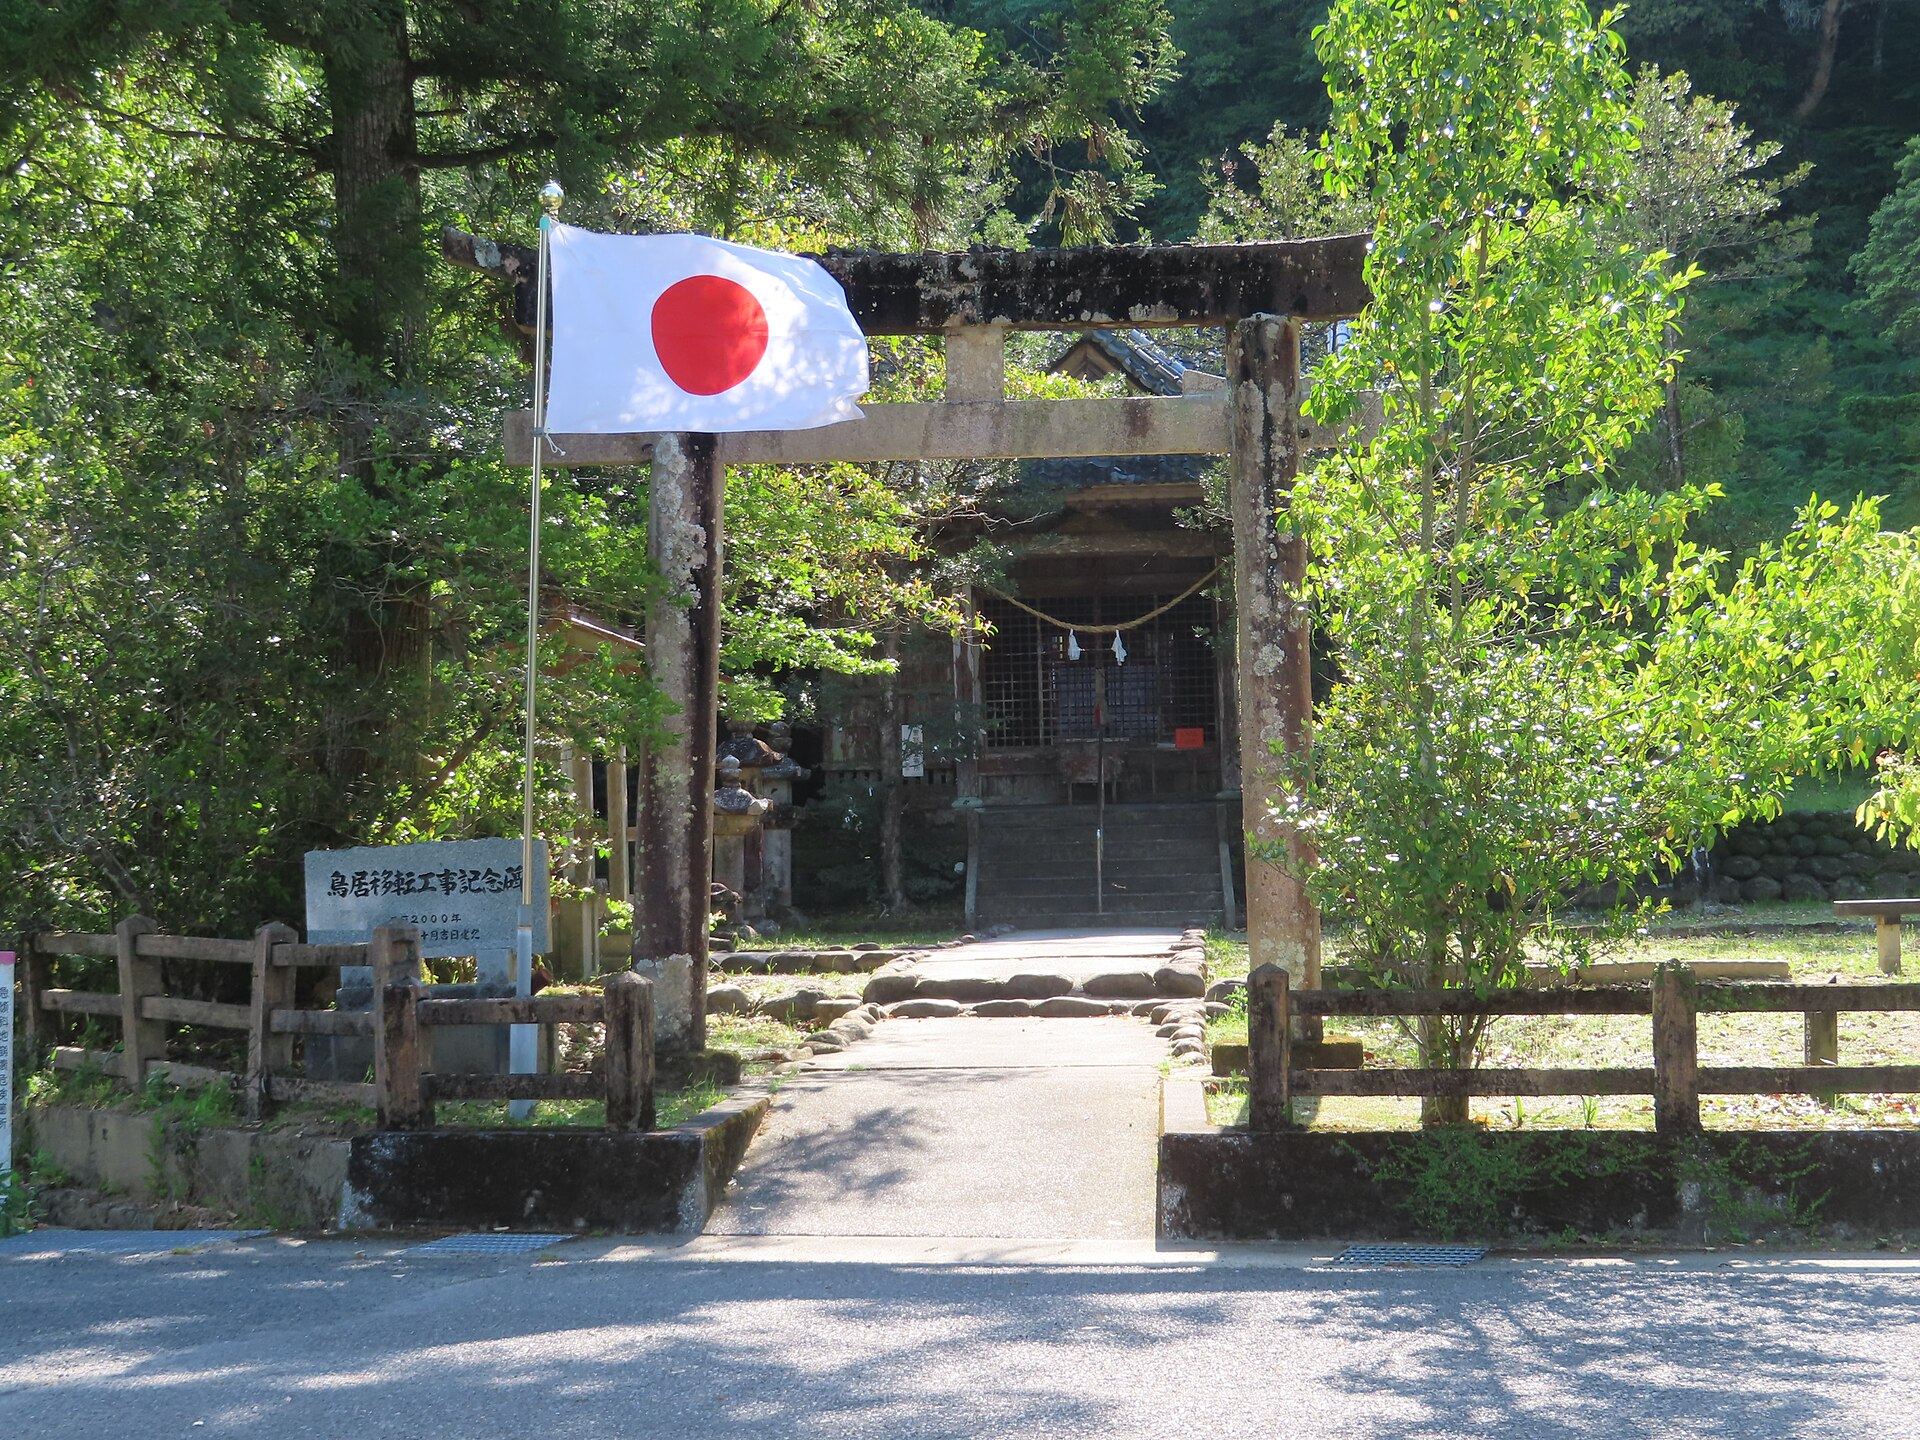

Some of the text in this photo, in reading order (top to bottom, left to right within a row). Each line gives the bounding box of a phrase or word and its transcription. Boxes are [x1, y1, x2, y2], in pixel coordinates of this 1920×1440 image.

[327, 864, 524, 898] 鳥居移転工事記念碑
